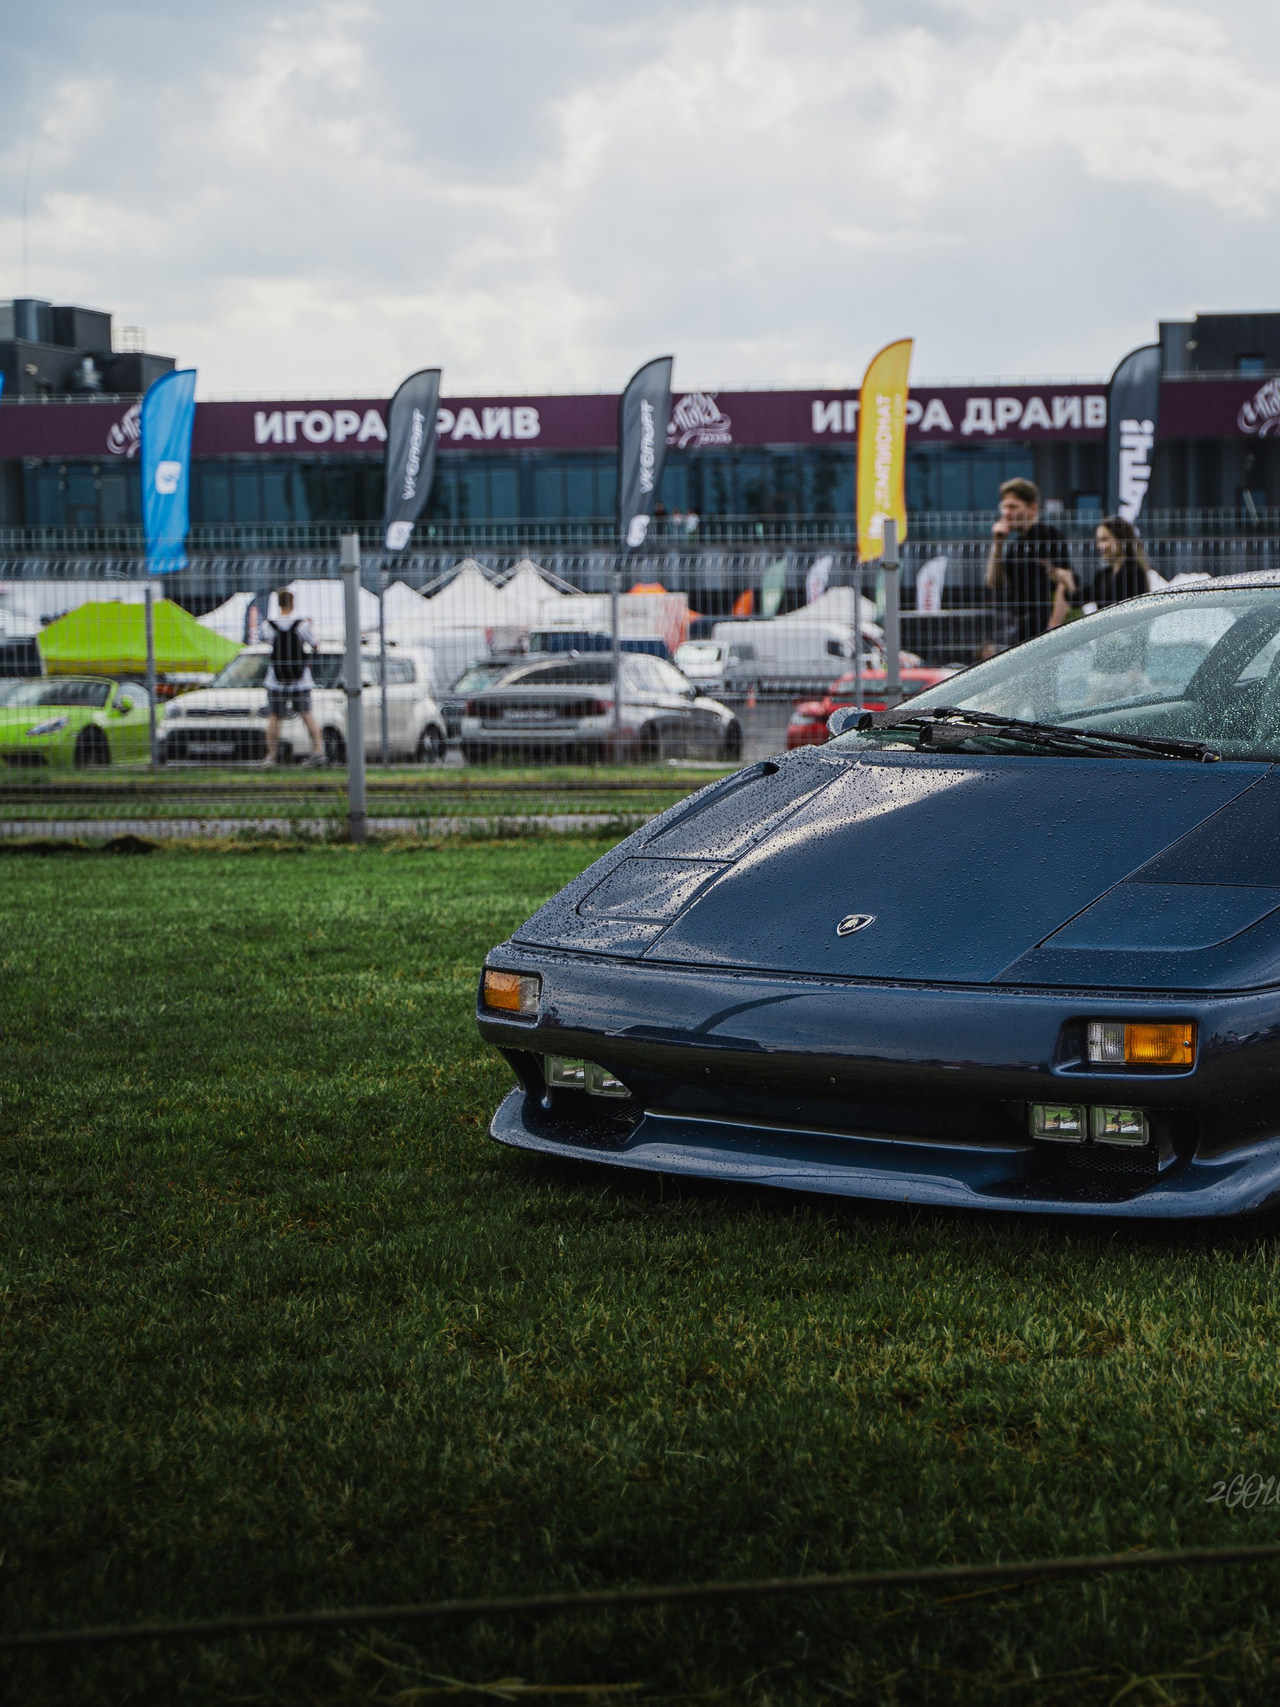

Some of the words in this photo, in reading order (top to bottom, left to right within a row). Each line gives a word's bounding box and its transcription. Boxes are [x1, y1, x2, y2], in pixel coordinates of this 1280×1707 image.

[254, 409, 388, 444] ИГОРА
[433, 406, 541, 441] РАЙВ
[811, 398, 953, 435] ИГРА
[961, 395, 1107, 436] ДРАЙВ
